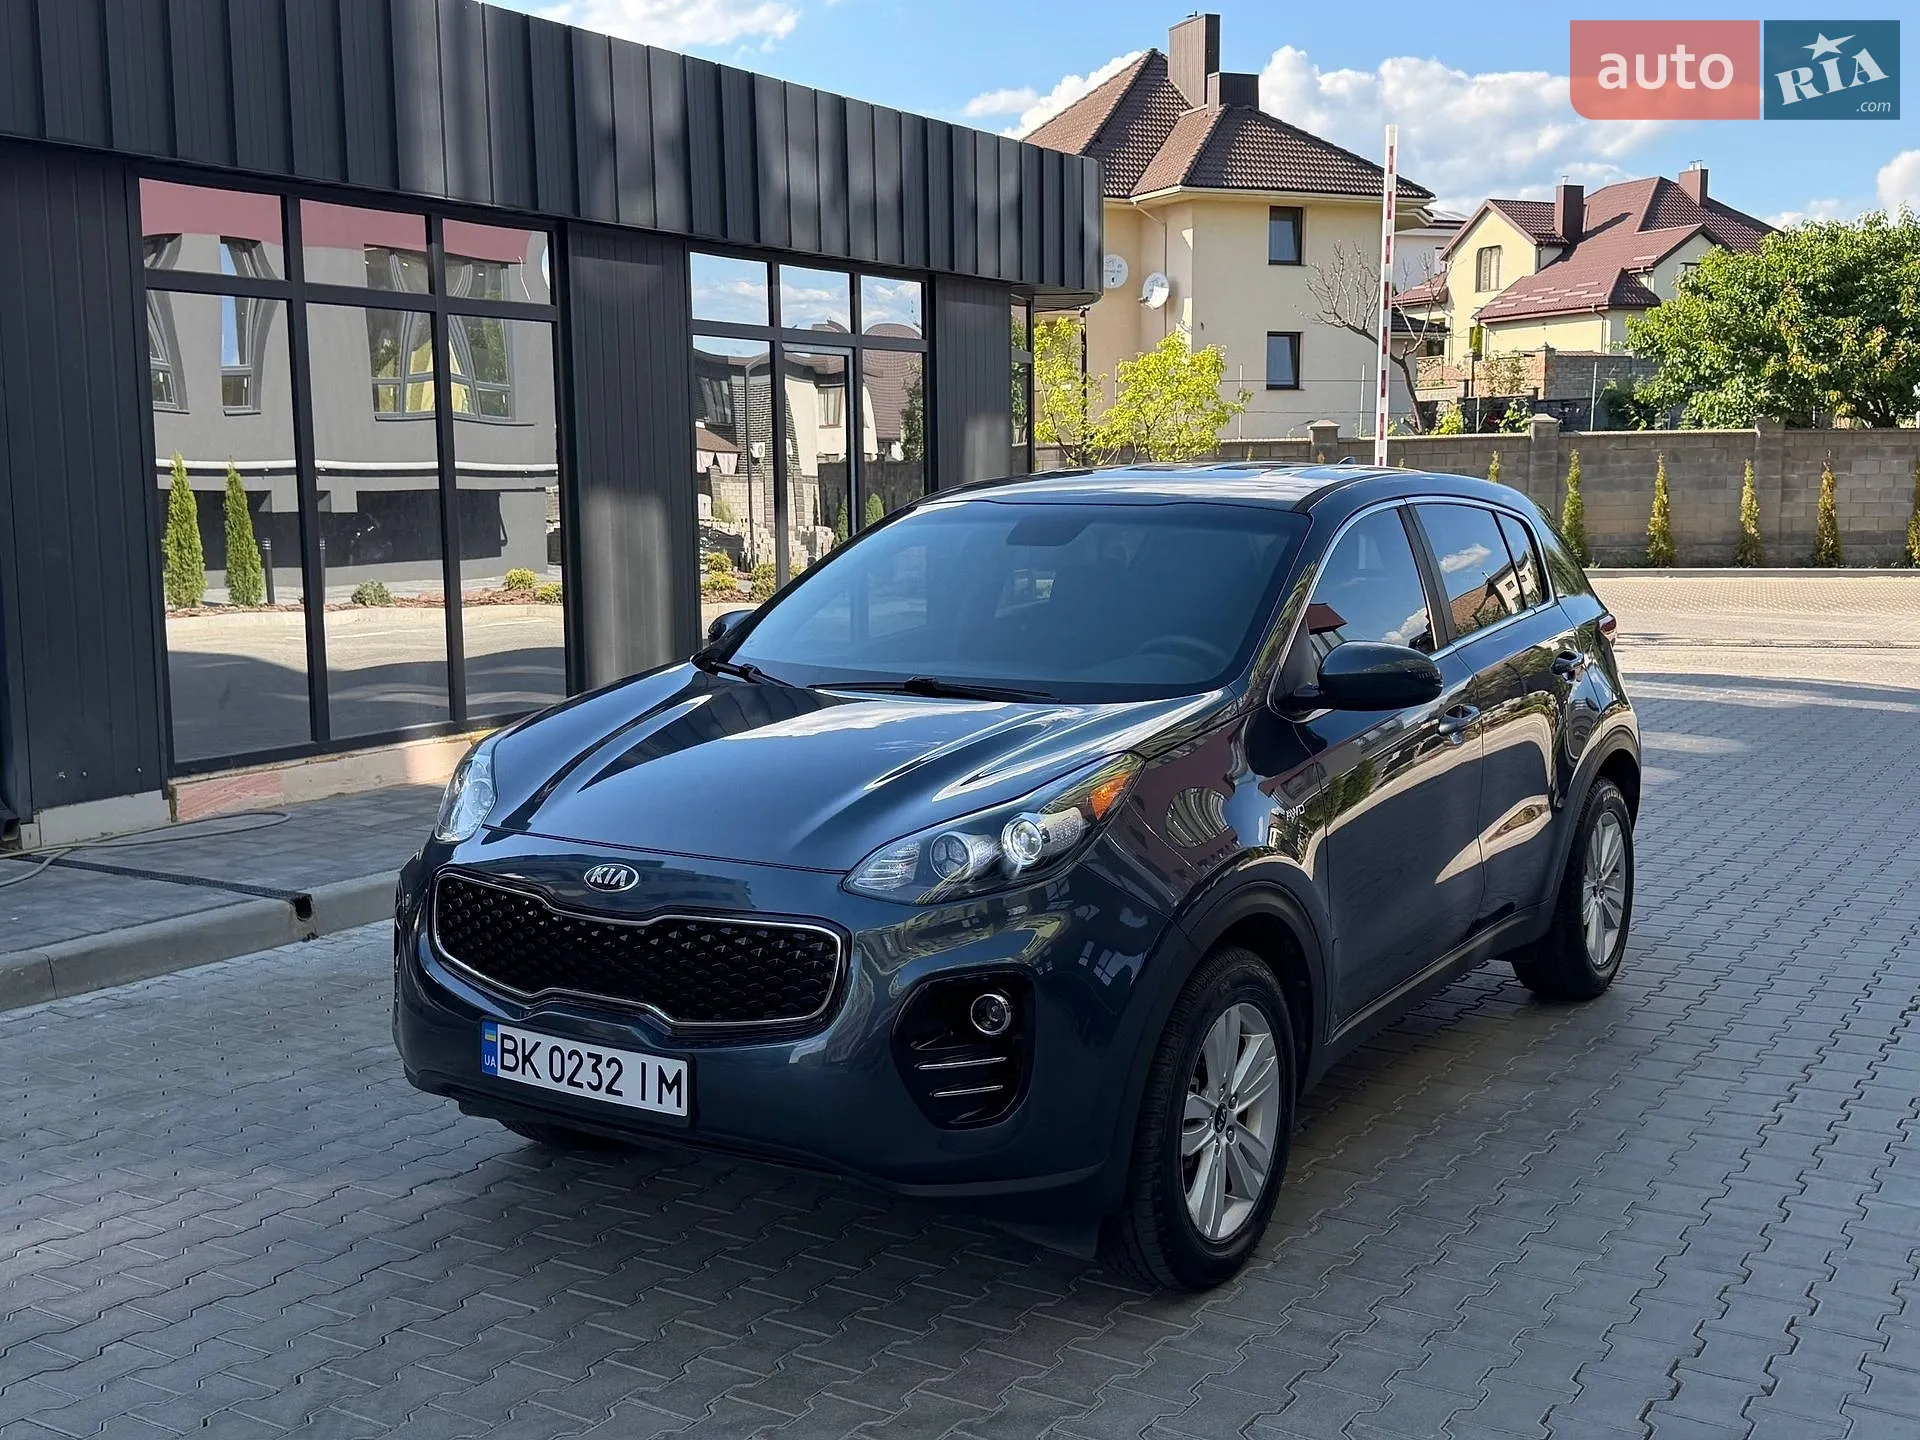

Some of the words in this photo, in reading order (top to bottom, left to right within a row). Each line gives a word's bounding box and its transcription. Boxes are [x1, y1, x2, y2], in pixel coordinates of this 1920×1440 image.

[1286, 804, 1305, 823] AWD
[590, 867, 627, 887] KIA
[484, 1054, 496, 1068] UA
[500, 1033, 542, 1079] BK
[549, 1045, 624, 1097] 0232
[640, 1062, 682, 1108] IM
